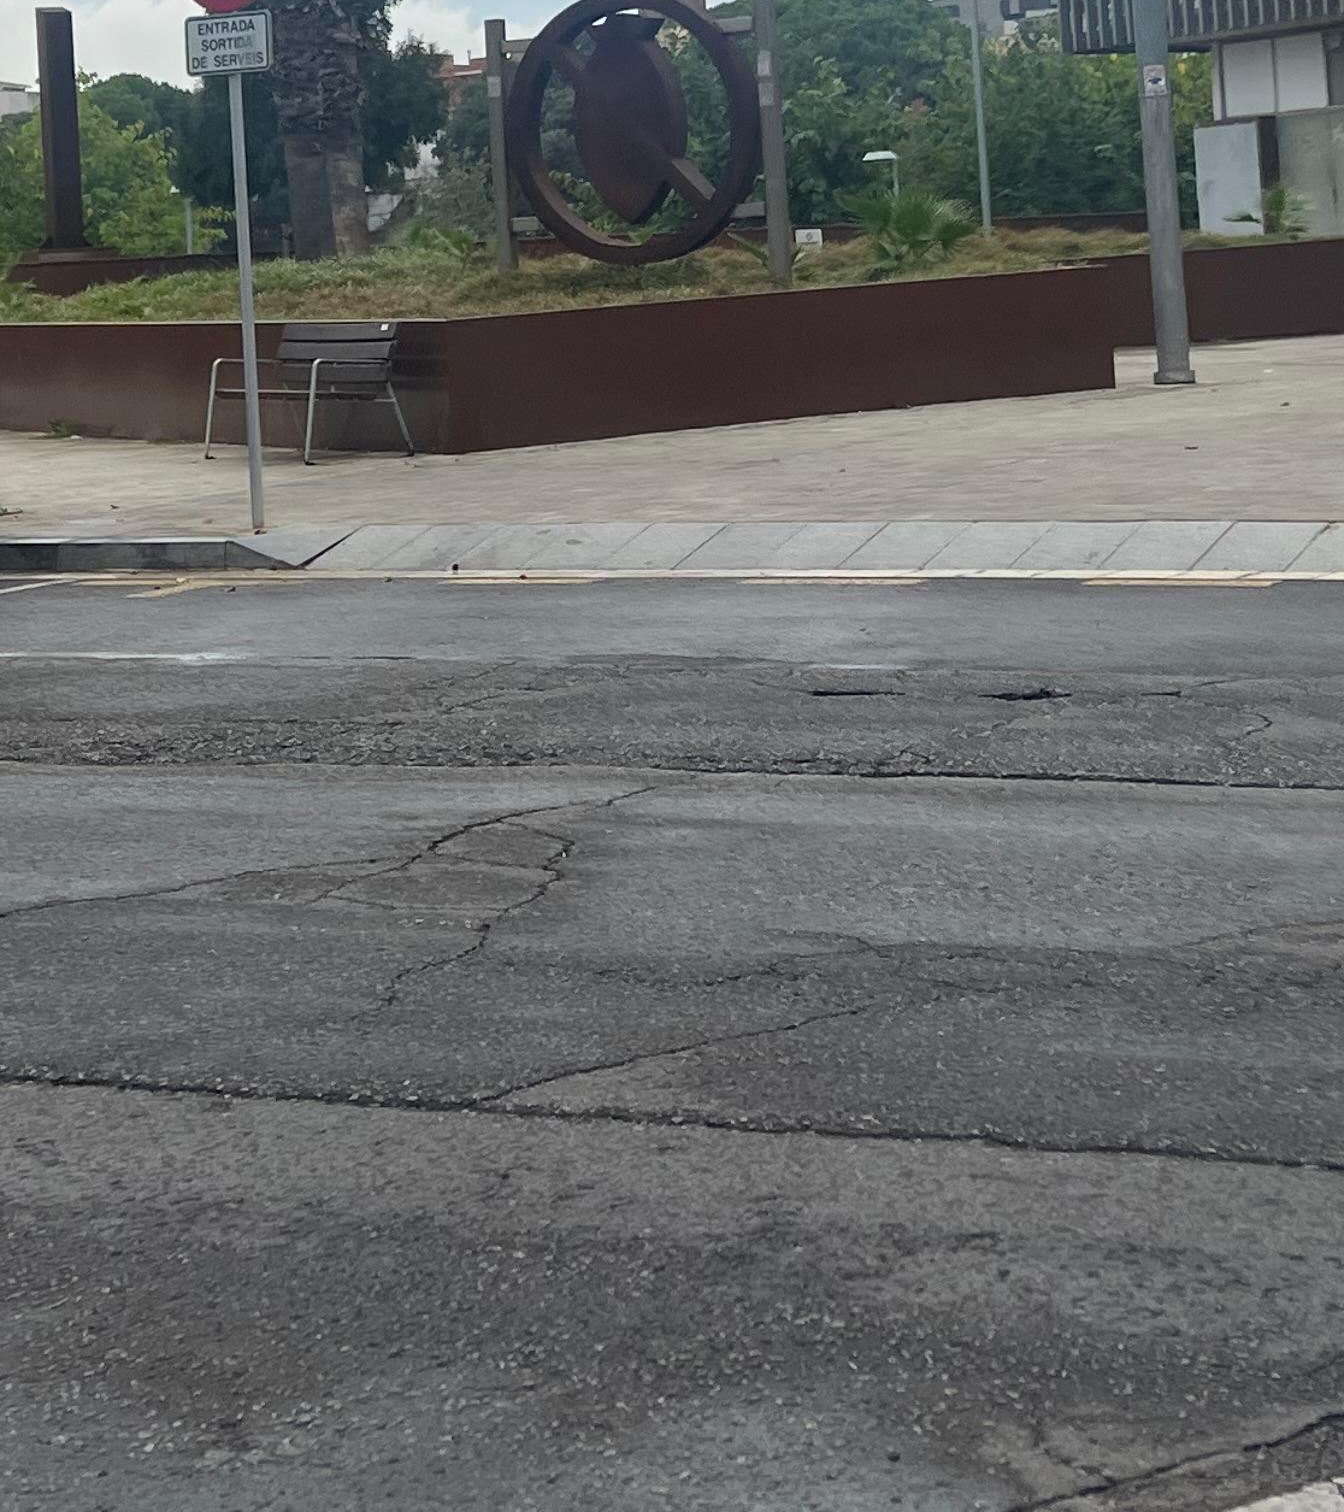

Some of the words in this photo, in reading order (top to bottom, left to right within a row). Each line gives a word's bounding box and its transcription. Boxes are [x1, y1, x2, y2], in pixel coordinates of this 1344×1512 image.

[198, 19, 255, 36] ENTRADA
[201, 36, 254, 52] SORTIDA
[192, 56, 208, 70] DE
[214, 51, 264, 68] SERVEIS
